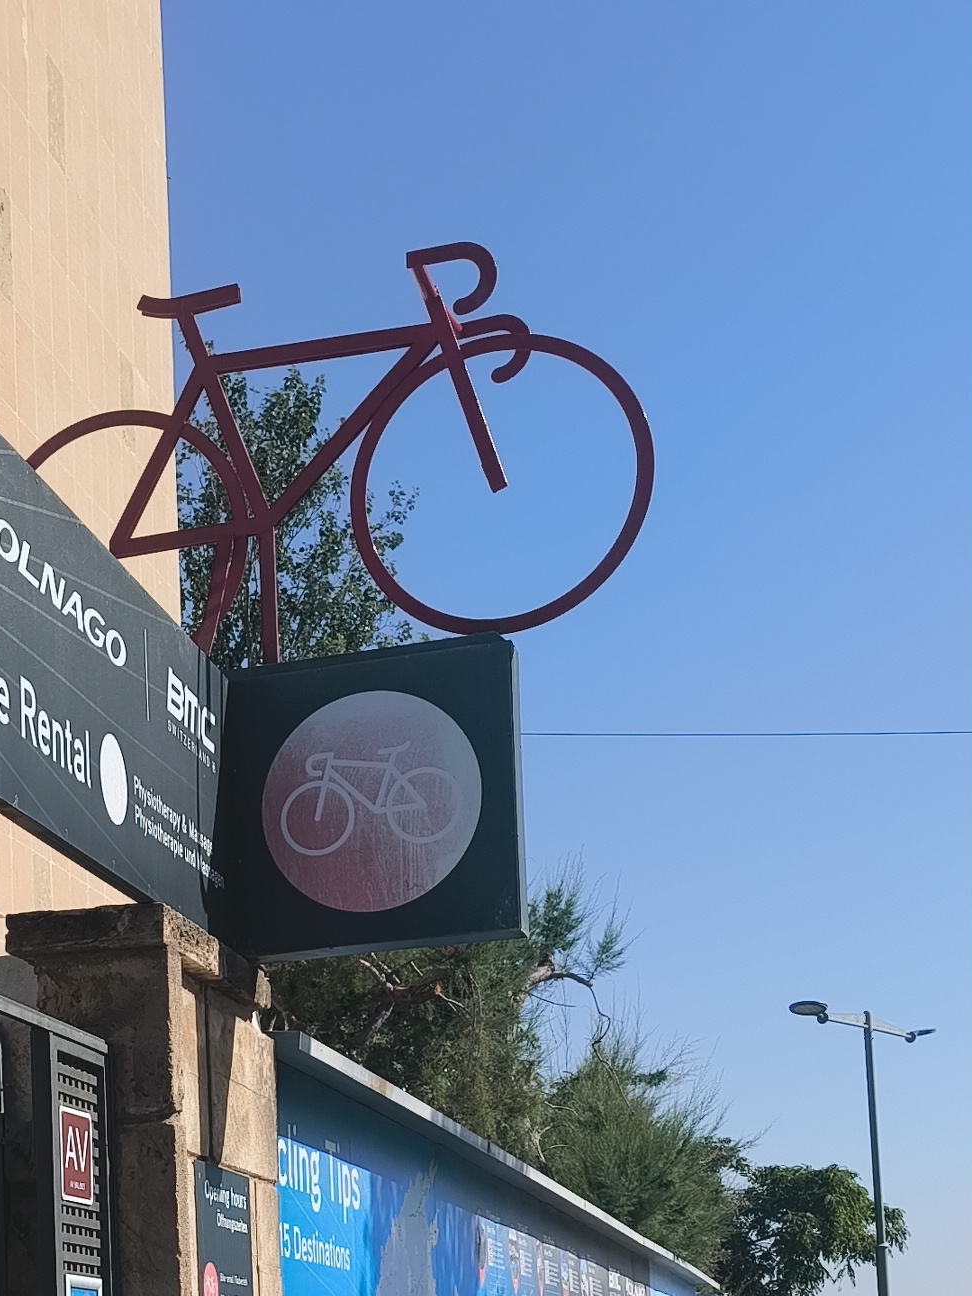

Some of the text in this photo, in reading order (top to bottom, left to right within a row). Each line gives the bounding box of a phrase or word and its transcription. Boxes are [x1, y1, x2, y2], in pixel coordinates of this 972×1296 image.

[19, 675, 92, 788] Rental
[167, 666, 216, 754] BMC
[133, 775, 181, 833] Physiotherapy
[181, 813, 187, 834] &
[134, 804, 183, 859] Physiotherapie
[184, 846, 196, 868] und
[65, 1126, 88, 1172] AV
[204, 1180, 247, 1209] Opening hours
[325, 1139, 360, 1224] Tips
[279, 1222, 351, 1271] 15 Destinations
